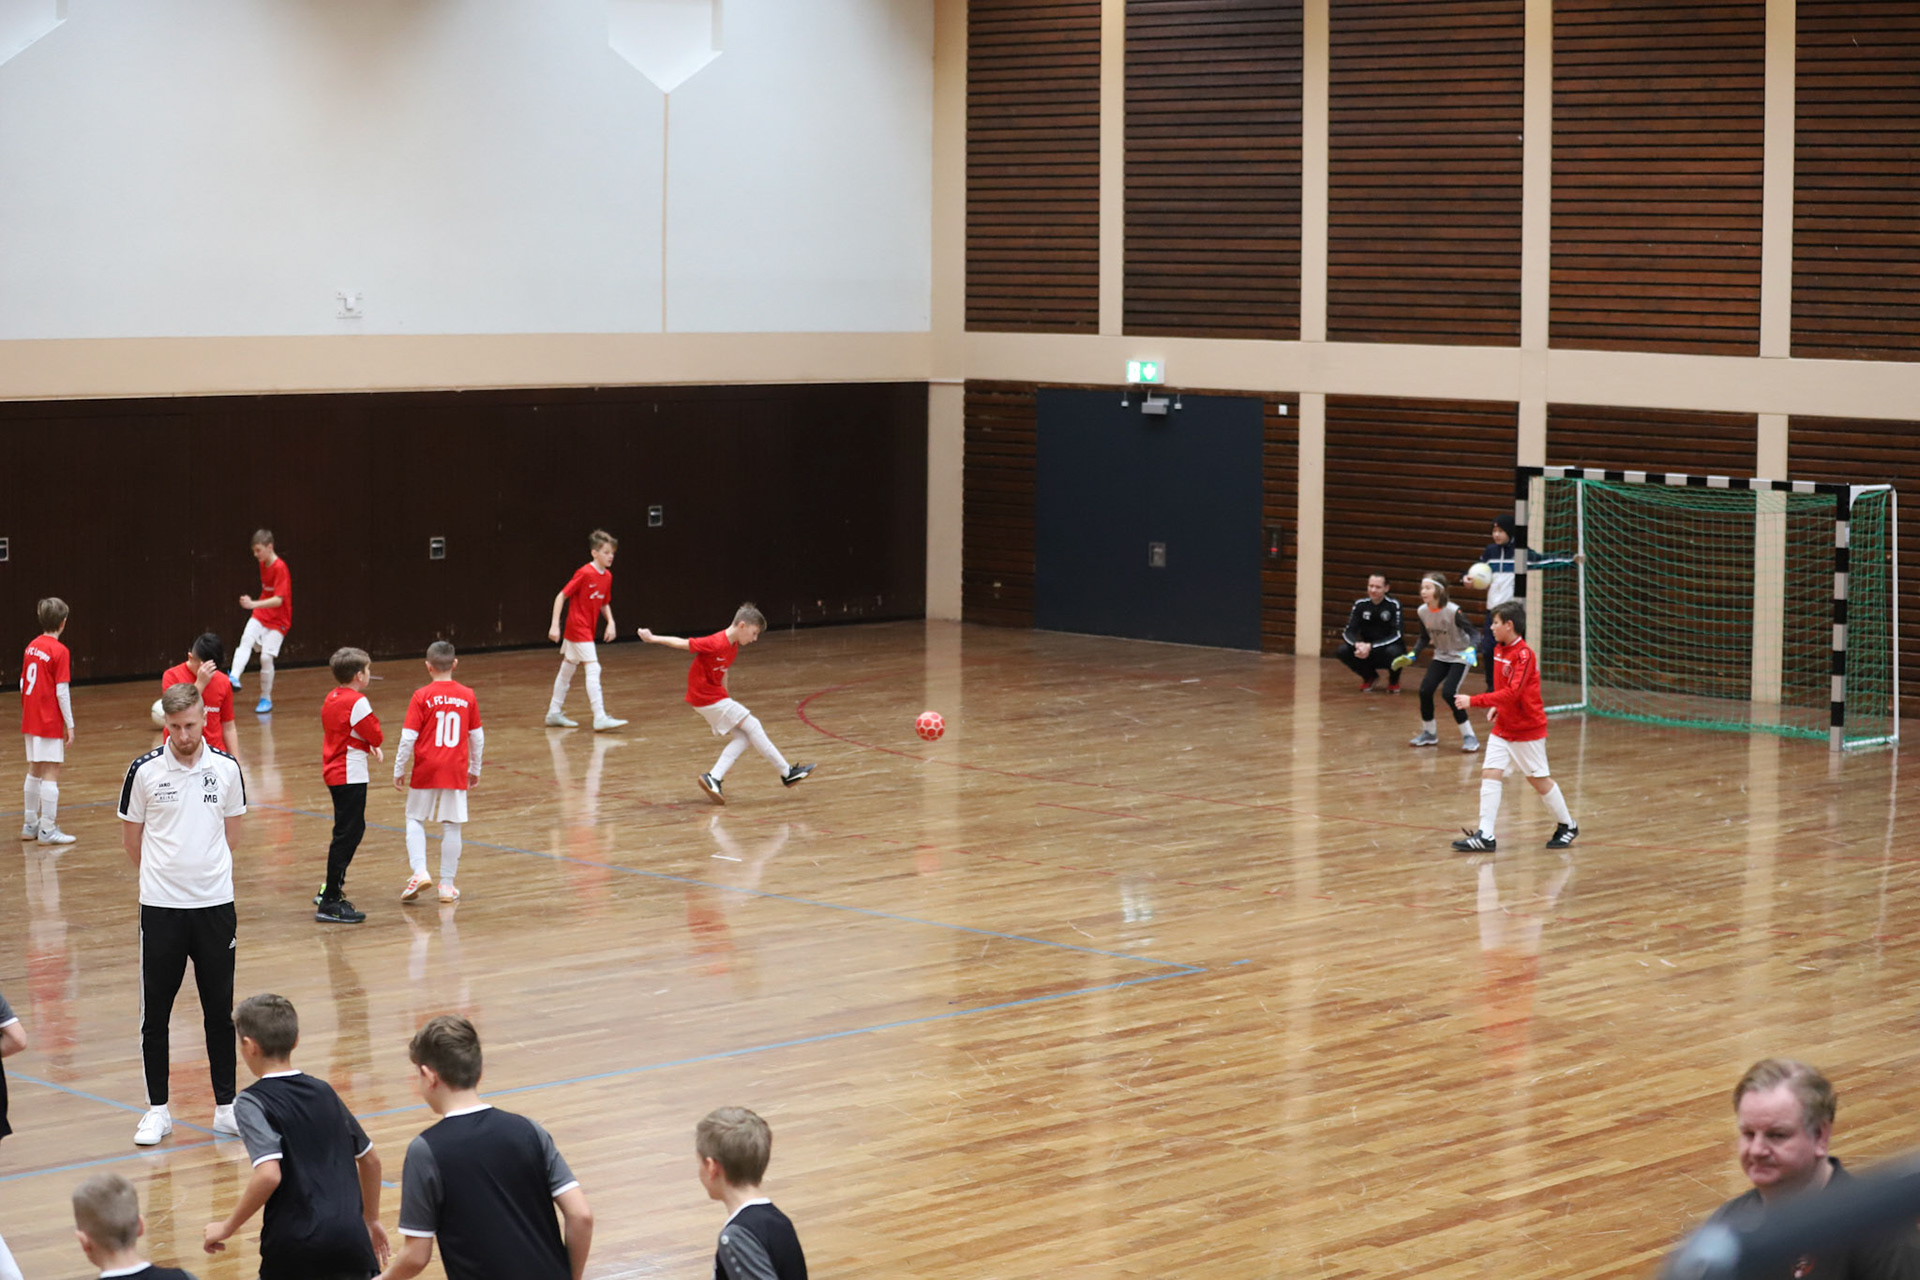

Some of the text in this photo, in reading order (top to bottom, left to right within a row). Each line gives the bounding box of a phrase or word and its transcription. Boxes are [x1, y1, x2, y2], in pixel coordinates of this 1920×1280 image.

[25, 662, 37, 695] 9
[433, 695, 443, 705] FC
[435, 711, 460, 747] 10
[203, 794, 218, 803] MB
